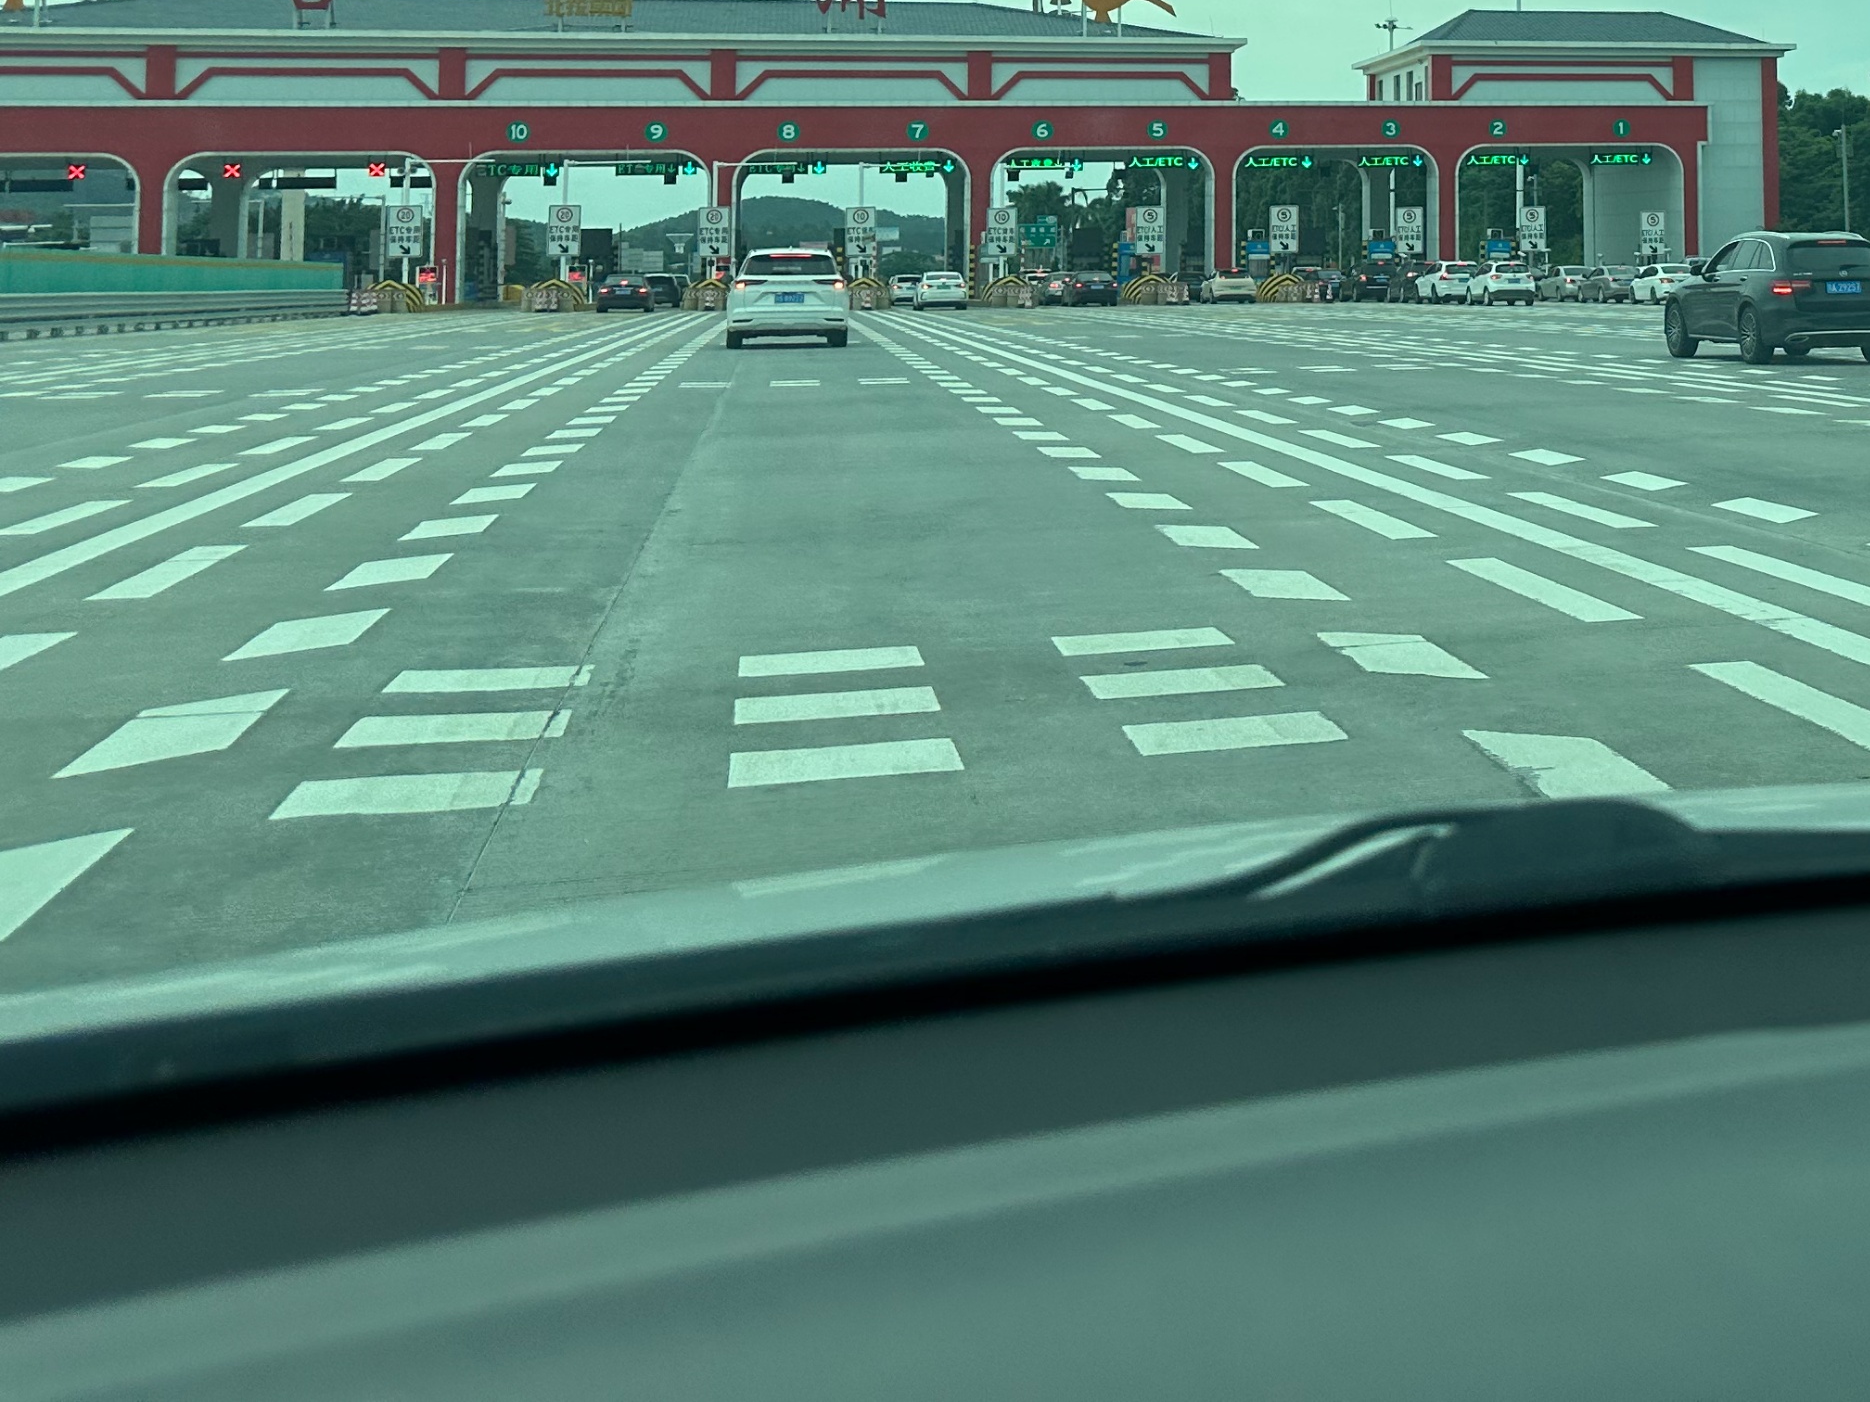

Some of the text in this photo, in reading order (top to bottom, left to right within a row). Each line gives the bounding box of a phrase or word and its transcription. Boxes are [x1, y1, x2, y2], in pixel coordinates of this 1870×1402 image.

[510, 124, 528, 140] 10
[650, 125, 663, 139] 9
[782, 125, 796, 139] 8
[912, 124, 924, 138] 7
[1036, 123, 1049, 137] 6
[1152, 123, 1164, 137] 5
[1272, 122, 1284, 136] 4
[1385, 122, 1396, 135] 3
[1493, 122, 1504, 135] 2
[1128, 156, 1183, 168] 人工/ETC
[1245, 156, 1298, 168] 人工/ETC
[1358, 156, 1409, 167] 人工/ETC
[1467, 155, 1516, 166] 人工/ETC
[1590, 154, 1638, 165] 人工/ETC
